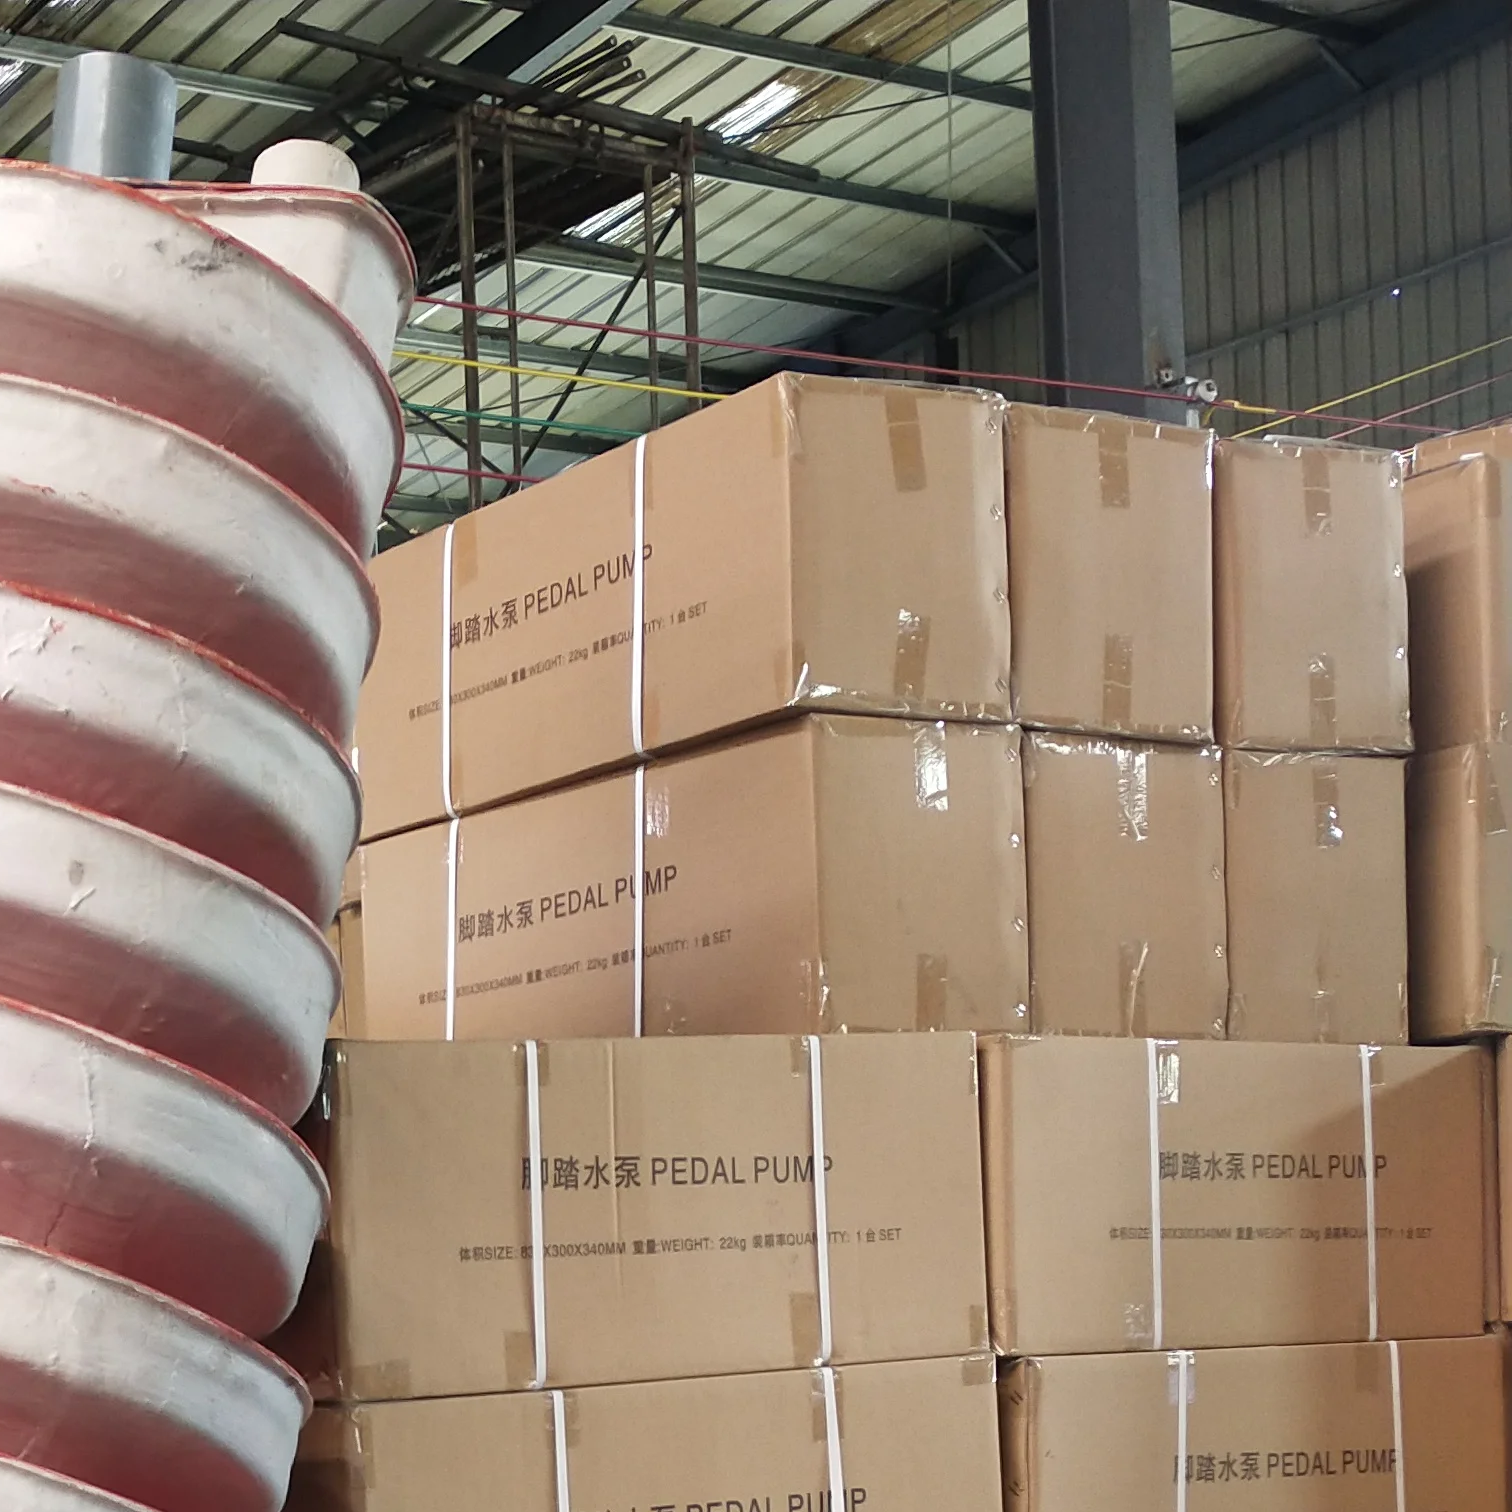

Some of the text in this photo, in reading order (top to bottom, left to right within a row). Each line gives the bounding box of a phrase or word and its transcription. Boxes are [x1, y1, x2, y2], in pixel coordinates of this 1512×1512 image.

[524, 572, 589, 620] PEDAL
[688, 600, 708, 619] SET
[457, 898, 534, 944] 脚踏水泵
[540, 882, 609, 922] PEDAL
[712, 928, 732, 945] SET
[651, 1156, 746, 1187] PEDAL
[1158, 1150, 1246, 1182] 脚踏水泵
[1252, 1153, 1324, 1180] PEDAL
[719, 1236, 747, 1252] 22kg
[879, 1227, 902, 1241] SET
[1267, 1450, 1338, 1479] PEDAL
